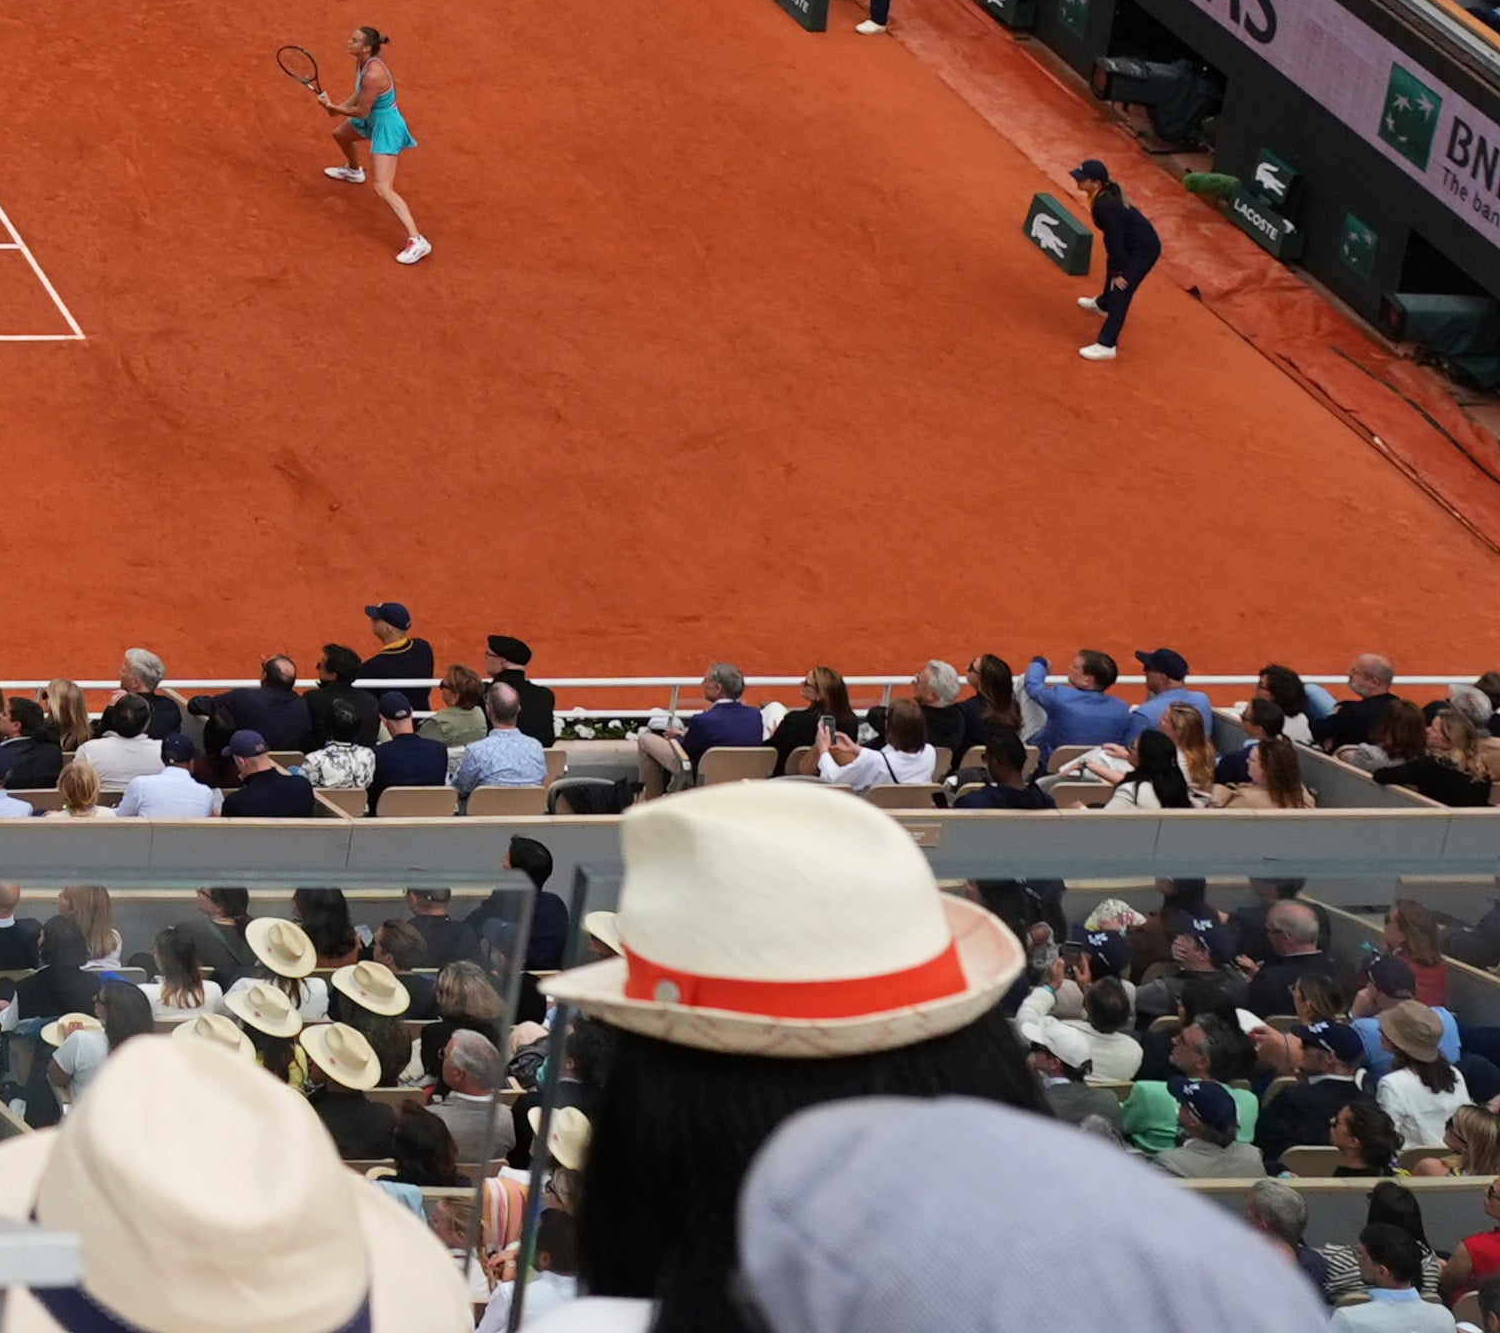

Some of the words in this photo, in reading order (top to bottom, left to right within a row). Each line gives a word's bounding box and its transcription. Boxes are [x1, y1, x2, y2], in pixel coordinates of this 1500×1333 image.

[1446, 115, 1500, 199] BN
[1233, 197, 1279, 242] LACOSTE
[1442, 166, 1469, 201] The
[1472, 191, 1500, 227] ban
